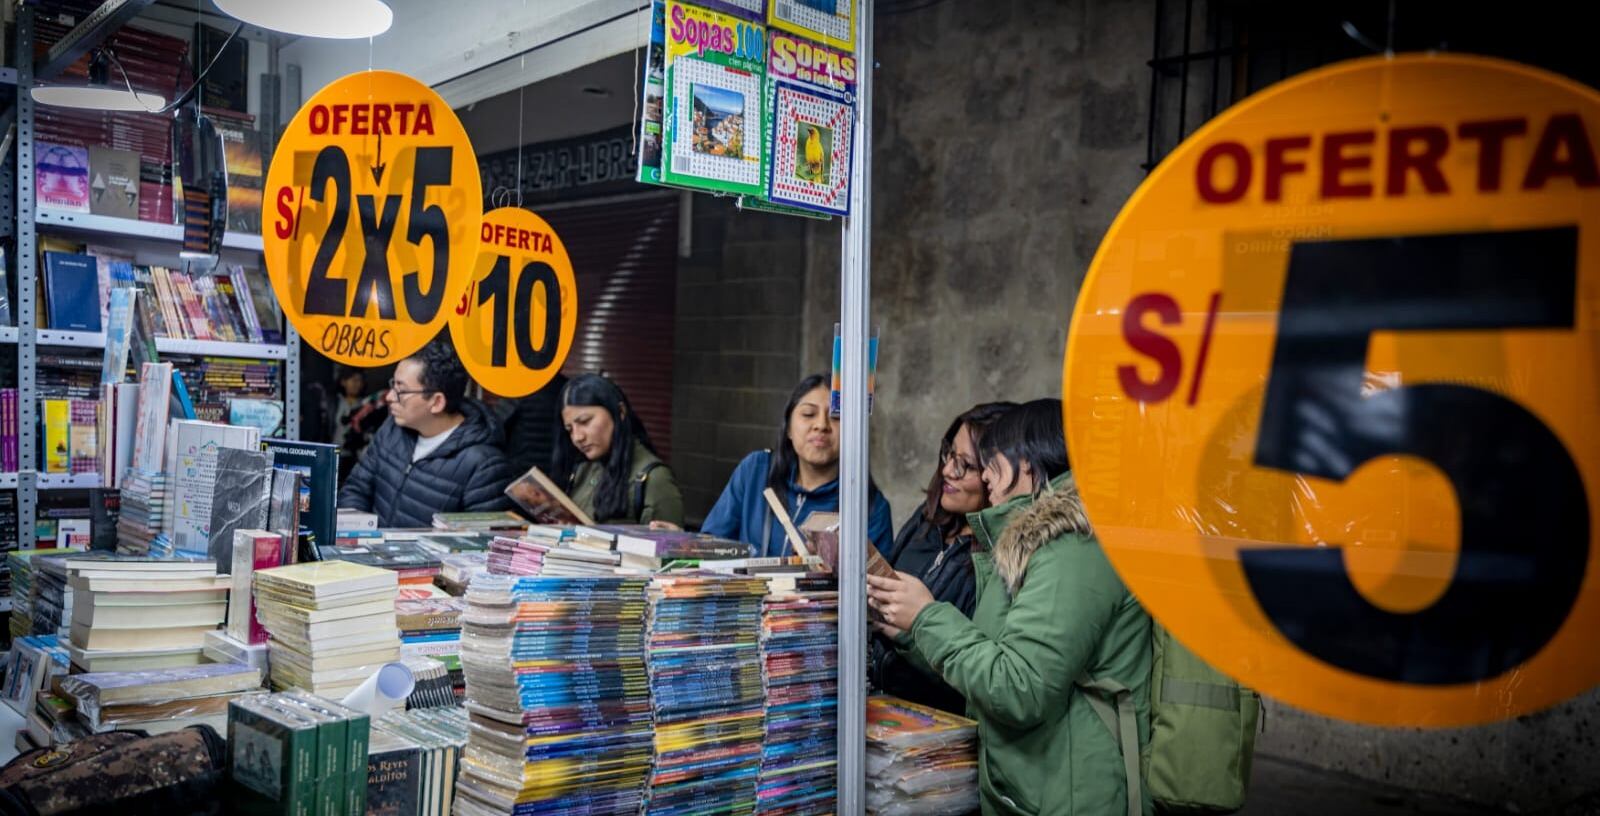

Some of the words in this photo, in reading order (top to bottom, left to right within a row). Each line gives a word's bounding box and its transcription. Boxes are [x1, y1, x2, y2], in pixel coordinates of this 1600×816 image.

[671, 4, 734, 57] Sopas
[736, 21, 764, 62] 100
[773, 36, 855, 81] SOPAS
[797, 68, 812, 81] de
[813, 72, 846, 92] letras
[309, 104, 434, 136] OFERTA
[1194, 113, 1600, 204] OFERTA
[303, 145, 453, 326] 2x5
[480, 222, 553, 254] OFERTA
[478, 255, 562, 371] 10
[321, 322, 390, 358] OBRAS
[289, 447, 317, 457] GEOGRAPHIC
[1238, 225, 1588, 687] 5
[368, 764, 376, 772] OS
[368, 771, 407, 784] ALDITOS
